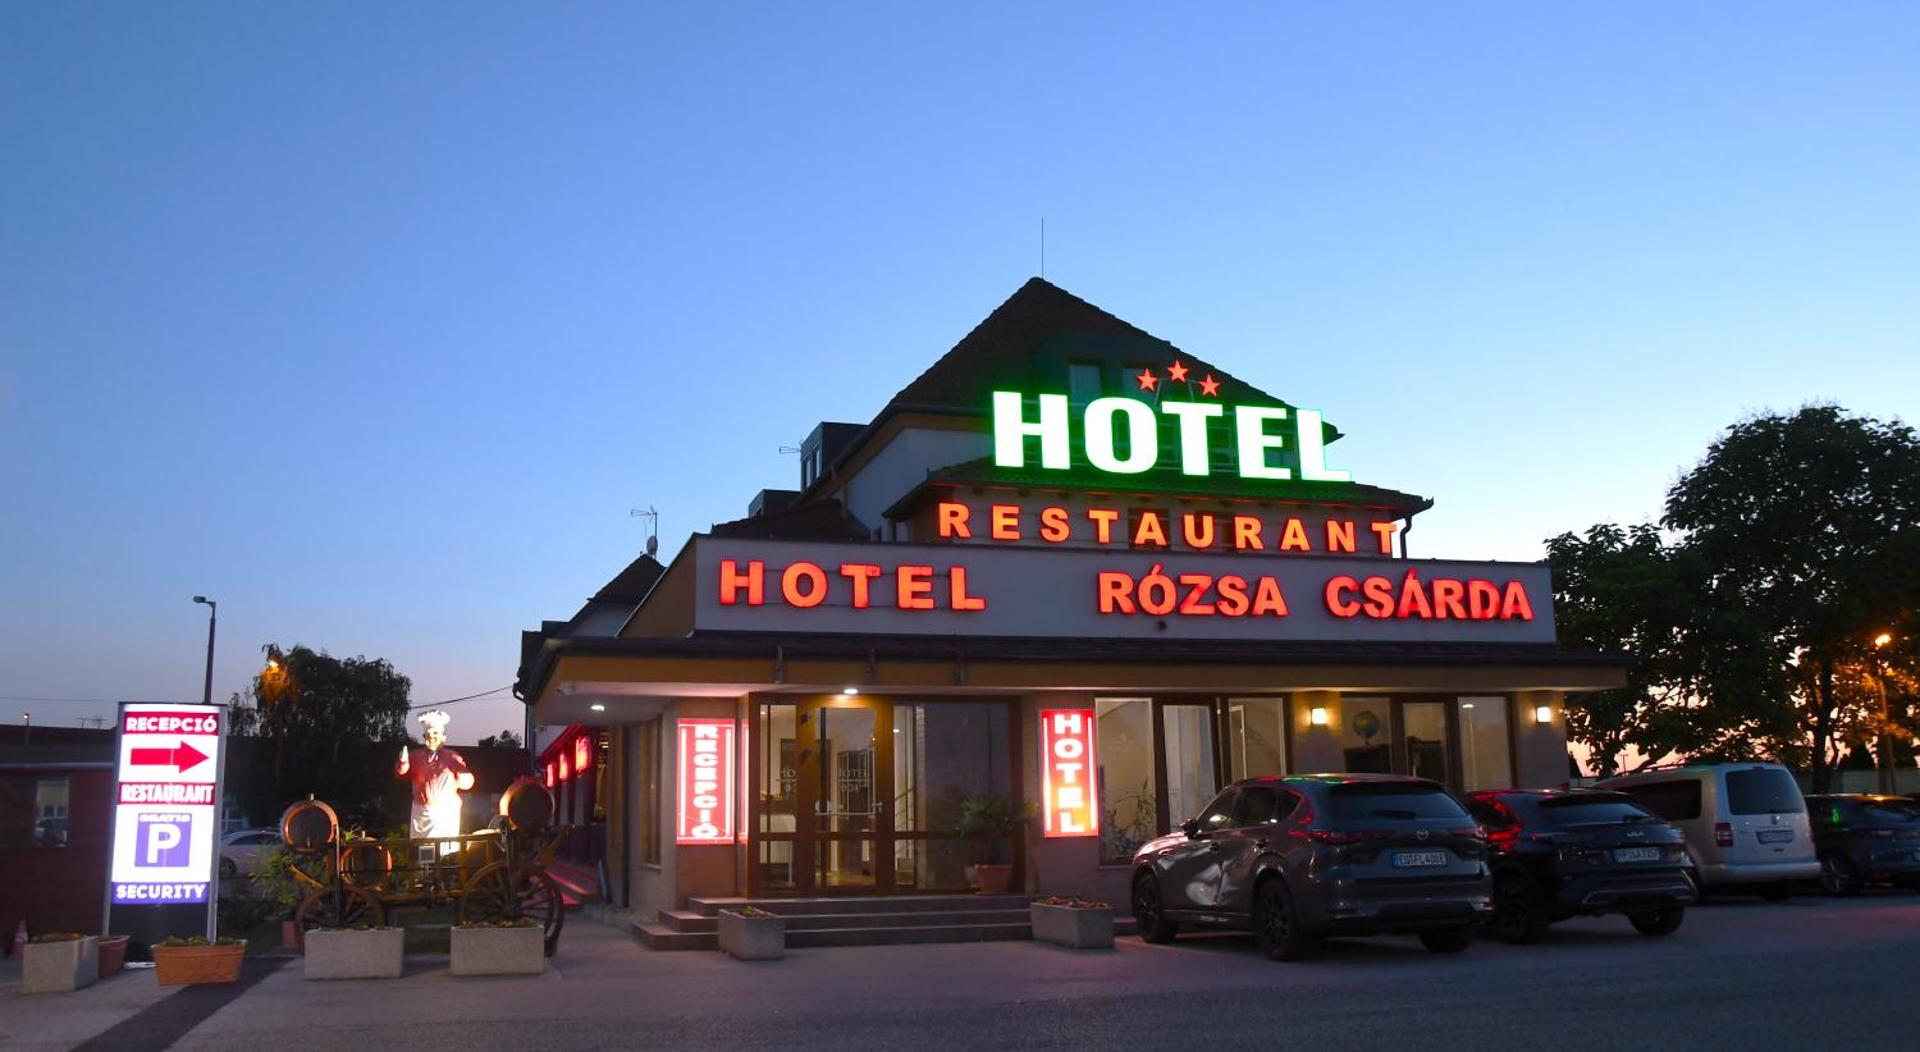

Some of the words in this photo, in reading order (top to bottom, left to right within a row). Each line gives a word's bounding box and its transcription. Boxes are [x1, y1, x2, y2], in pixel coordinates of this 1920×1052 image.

[993, 391, 1351, 481] HOTEL
[938, 502, 1397, 554] RESTAURANT
[719, 559, 986, 610] HOTEL
[1098, 563, 1288, 617] RÓZSA
[1325, 566, 1534, 621] CSÁRDA
[126, 715, 217, 732] RECEPCIÓ
[120, 783, 214, 803] RESTAURANT
[1054, 714, 1085, 833] HOTEL
[146, 823, 182, 864] P
[116, 884, 206, 899] SECURITY
